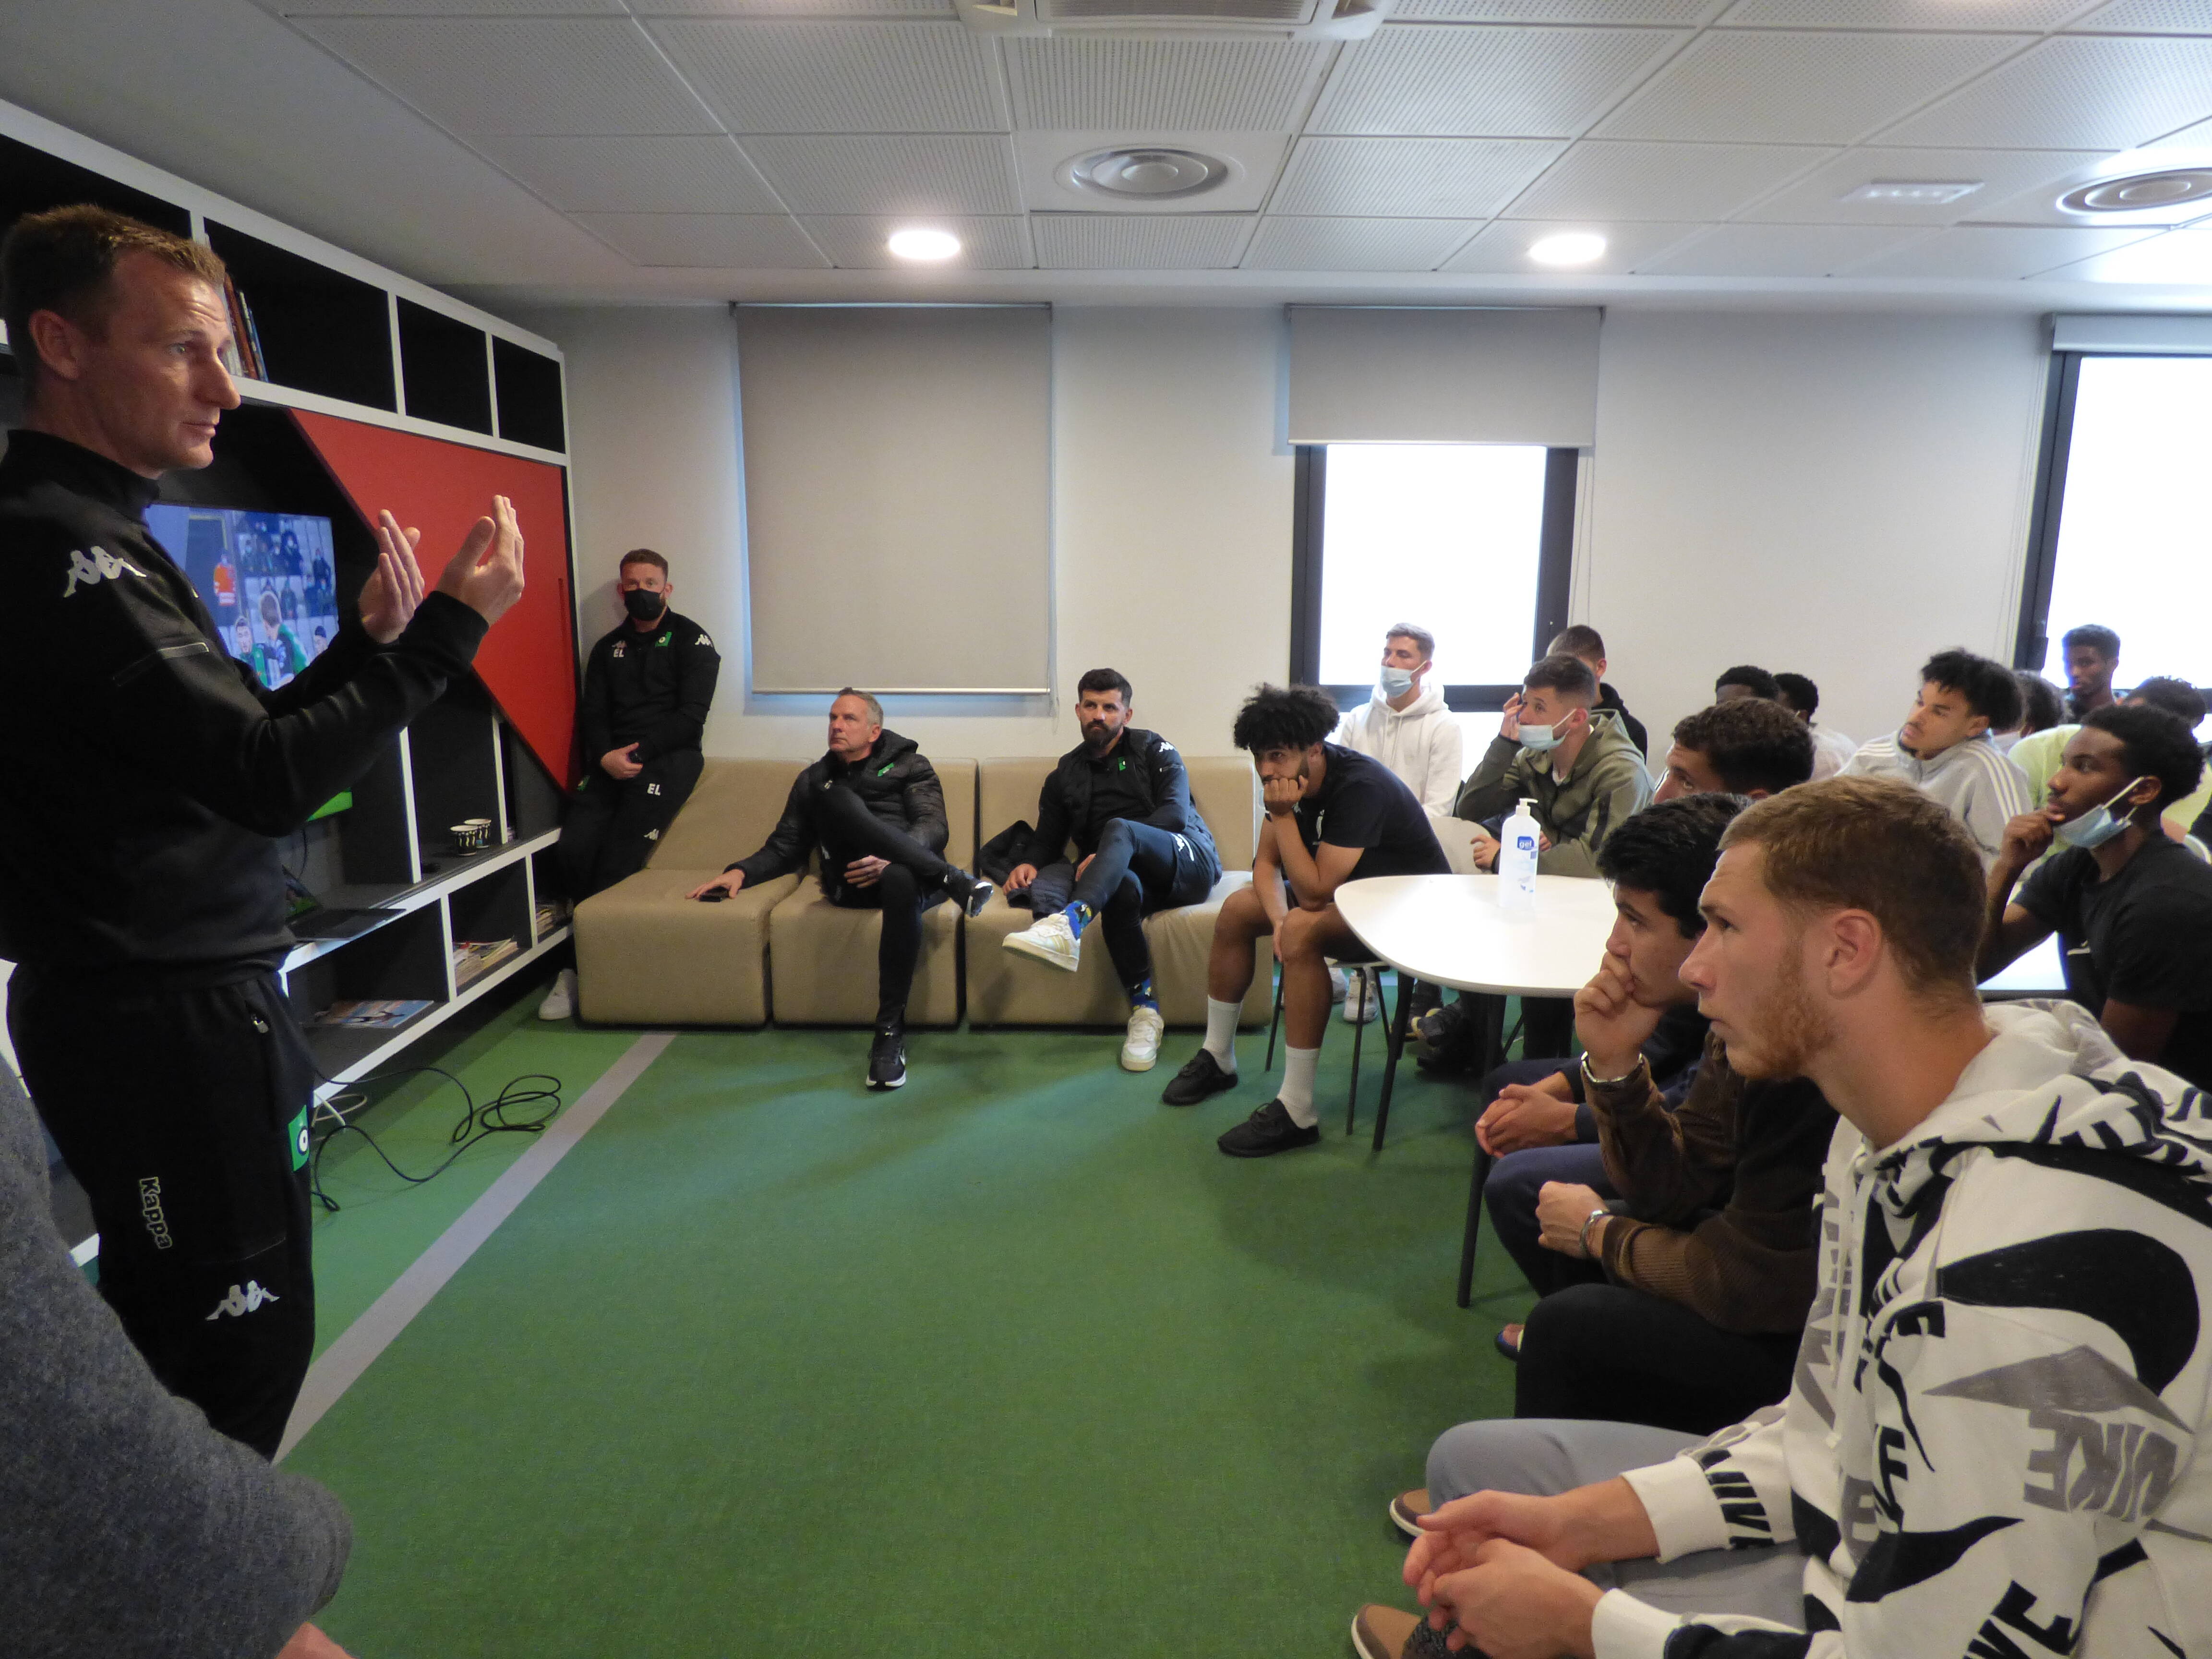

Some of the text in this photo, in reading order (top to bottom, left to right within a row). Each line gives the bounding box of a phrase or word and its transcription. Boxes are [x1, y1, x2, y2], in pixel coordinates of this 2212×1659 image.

[613, 649, 625, 658] EL
[647, 783, 661, 796] EL
[139, 1177, 173, 1250] Kappa
